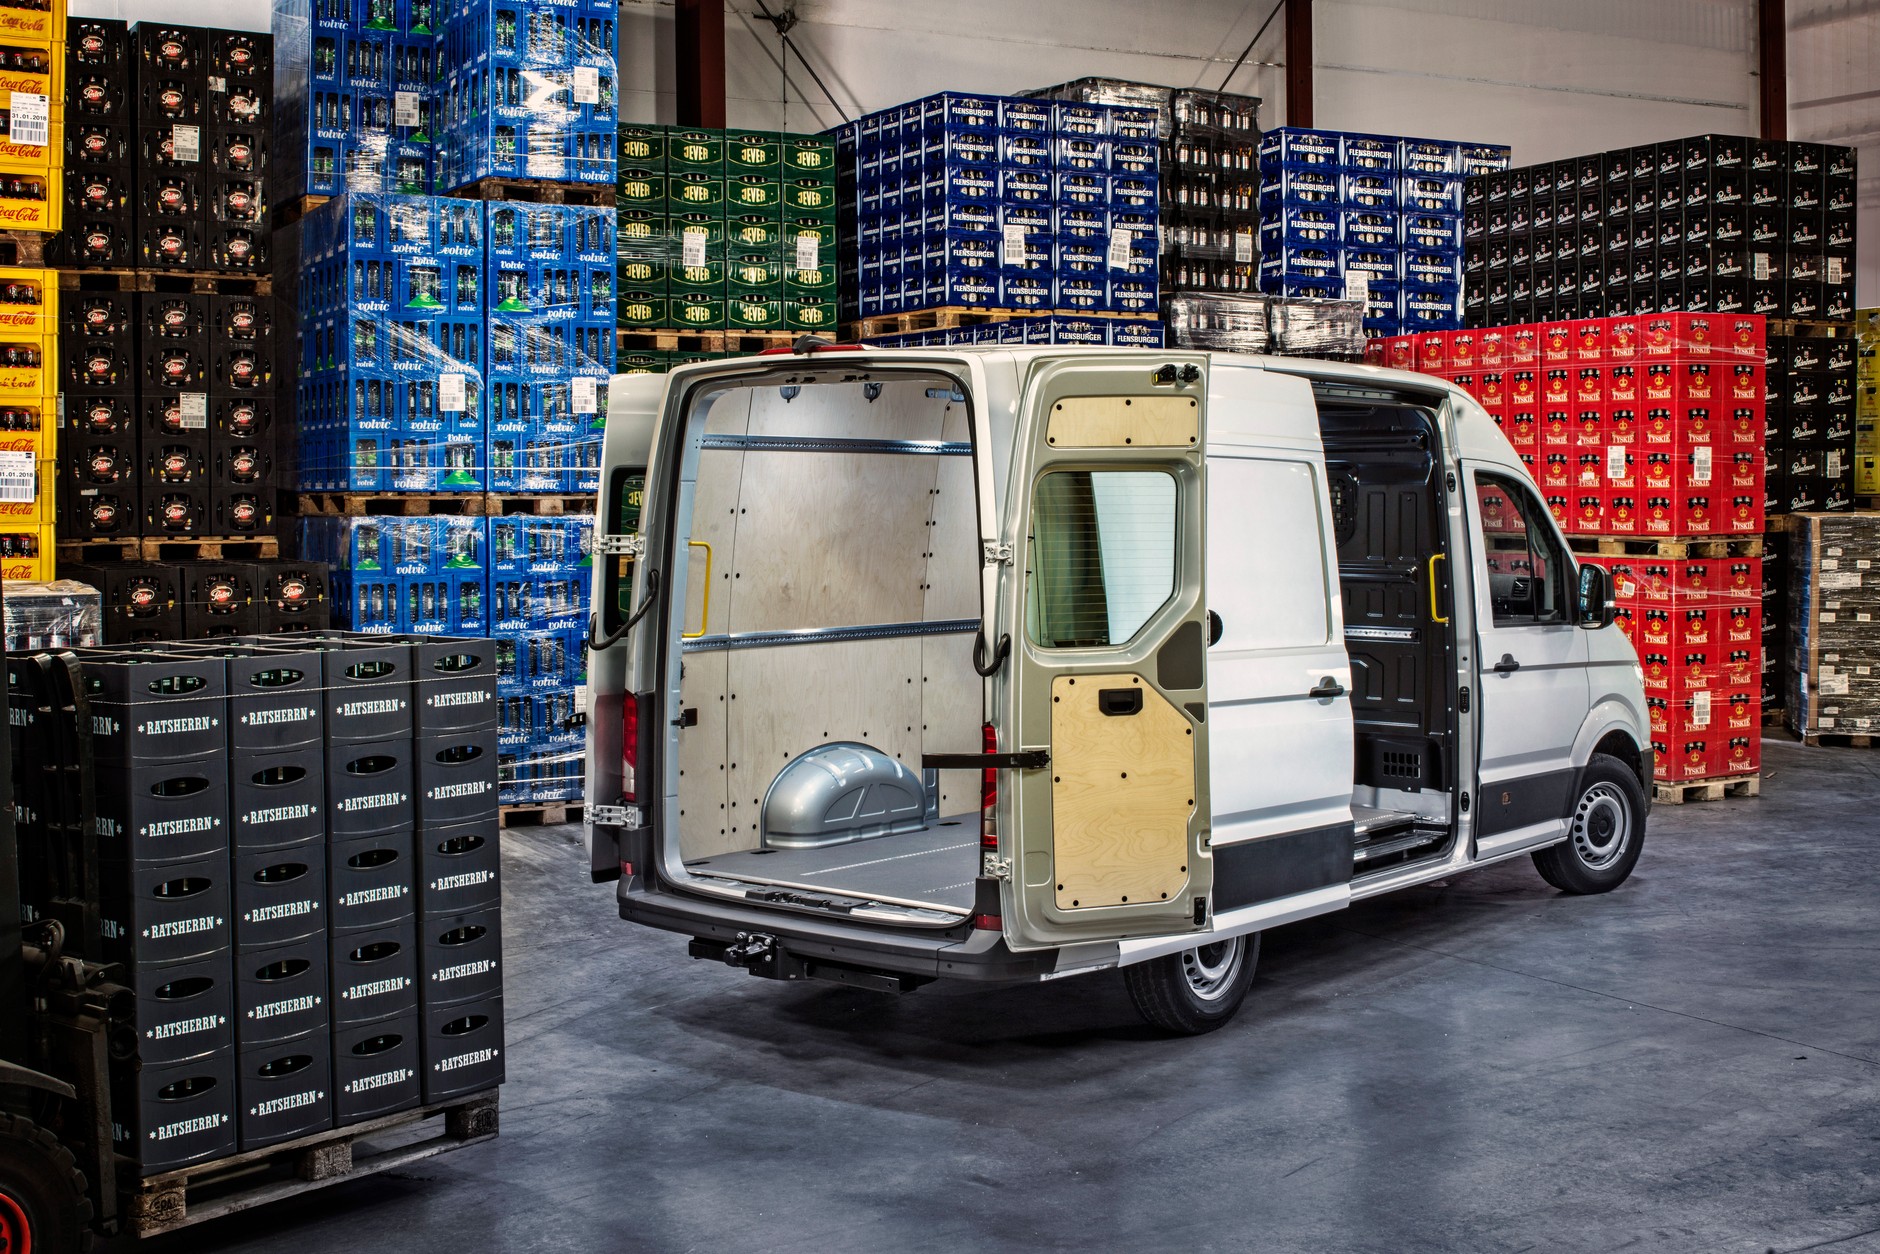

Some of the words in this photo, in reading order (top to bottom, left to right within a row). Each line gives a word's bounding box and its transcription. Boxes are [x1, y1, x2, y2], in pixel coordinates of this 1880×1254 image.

[319, 19, 348, 29] volvic
[351, 78, 379, 88] volvic
[398, 83, 427, 92] volvic
[11, 113, 47, 121] 31.01.2018
[498, 107, 528, 118] volvic
[952, 107, 993, 117] FLENSBURGER
[1007, 112, 1047, 121] FLENSBURGER
[318, 129, 347, 139] volvic
[625, 142, 649, 156] JEVER
[684, 145, 708, 160] JEVER
[953, 142, 993, 152] FLENSBURGER
[1290, 144, 1334, 155] FLENSBURGER
[742, 148, 765, 163] JEVER
[797, 152, 820, 166] JEVER
[1115, 154, 1153, 163] FLENSBURGER
[1349, 149, 1392, 159] FLENSBURGER
[580, 169, 608, 181] volvic
[953, 178, 994, 187] FLENSBURGER
[1008, 181, 1047, 191] FLENSBURGER
[1291, 182, 1335, 193] FLENSBURGER
[625, 182, 649, 197] JEVER
[684, 186, 708, 201] JEVER
[741, 188, 765, 202] JEVER
[1064, 185, 1102, 194] FLENSBURGER
[1115, 188, 1153, 196] FLENSBURGER
[798, 191, 821, 206] JEVER
[953, 212, 994, 223] FLENSBURGER
[1008, 216, 1047, 225] FLENSBURGER
[1064, 219, 1102, 228] FLENSBURGER
[1115, 223, 1153, 231] FLENSBURGER
[1291, 221, 1335, 231] FLENSBURGER
[1350, 224, 1392, 233] FLENSBURGER
[625, 223, 650, 238] JEVER
[742, 228, 766, 242] JEVER
[1410, 227, 1451, 237] FLENSBURGER
[391, 244, 424, 255] volvic
[442, 245, 474, 257] volvic
[953, 249, 994, 257] FLENSBURGER
[580, 253, 608, 262] volvic
[1063, 254, 1102, 262] FLENSBURGER
[1291, 257, 1335, 269] FLENSBURGER
[626, 264, 651, 279] JEVER
[1349, 262, 1392, 272] FLENSBURGER
[1410, 264, 1451, 273] FLENSBURGER
[685, 266, 709, 281] JEVER
[742, 267, 766, 282] JEVER
[798, 269, 821, 284] JEVER
[954, 284, 994, 293] FLENSBURGER
[1008, 287, 1048, 296] FLENSBURGER
[1063, 288, 1102, 297] FLENSBURGER
[358, 300, 389, 312] volvic
[627, 304, 651, 319] JEVER
[1410, 302, 1451, 312] FLENSBURGER
[547, 308, 576, 319] volvic
[686, 307, 710, 321] JEVER
[743, 307, 767, 321] JEVER
[800, 308, 822, 323] JEVER
[1059, 332, 1101, 341] FLENSBURGER
[1118, 335, 1158, 343] FLENSBURGER
[1546, 350, 1568, 360] TYSKIE
[1648, 345, 1670, 355] TYSKIE
[393, 360, 424, 370] volvic
[530, 364, 560, 375] volvic
[1513, 393, 1534, 404] TYSKIE
[1546, 391, 1568, 402] TYSKIE
[1578, 392, 1600, 402] TYSKIE
[1611, 389, 1635, 400] TYSKIE
[1647, 388, 1671, 399] TYSKIE
[1688, 388, 1711, 398] TYSKIE
[1733, 388, 1755, 398] TYSKIE
[359, 418, 390, 429] volvic
[410, 420, 442, 432] volvic
[497, 421, 527, 432] volvic
[546, 422, 575, 433] volvic
[1513, 435, 1534, 445] TYSKIE
[1612, 433, 1634, 443] TYSKIE
[1647, 432, 1671, 443] TYSKIE
[1688, 432, 1710, 442] TYSKIE
[1733, 432, 1755, 442] TYSKIE
[1646, 477, 1670, 488] TYSKIE
[1733, 476, 1754, 486] TYSKIE
[628, 491, 644, 506] JEV
[1578, 520, 1600, 530] TYSKIE
[1611, 520, 1634, 531] TYSKIE
[1687, 521, 1710, 531] TYSKIE
[1732, 520, 1754, 530] TYSKIE
[396, 563, 427, 574] volvic
[414, 621, 445, 632] volvic
[499, 619, 529, 630] volvic
[548, 618, 577, 629] volvic
[1644, 634, 1668, 644] TYSKIE
[1685, 634, 1708, 644] TYSKIE
[1729, 631, 1751, 641] TYSKIE
[533, 676, 561, 687] volvic
[434, 691, 483, 707] RATSHERRN
[344, 699, 398, 716] RATSHERRN
[250, 707, 307, 725] RATSHERRN
[147, 717, 209, 734] RATSHERRN
[1729, 718, 1750, 728] TYSKIE
[500, 734, 529, 744] volvic
[1684, 765, 1706, 776] TYSKIE
[434, 781, 485, 799] RATSHERRN
[345, 792, 399, 811] RATSHERRN
[251, 804, 308, 824] RATSHERRN
[149, 817, 211, 837] RATSHERRN
[438, 871, 487, 890] RATSHERRN
[347, 885, 400, 906] RATSHERRN
[252, 901, 310, 922] RATSHERRN
[152, 916, 213, 938] RATSHERRN
[439, 960, 489, 981] RATSHERRN
[350, 977, 403, 999] RATSHERRN
[256, 996, 313, 1019] RATSHERRN
[155, 1015, 216, 1039] RATSHERRN
[442, 1048, 491, 1071] RATSHERRN
[352, 1069, 406, 1093] RATSHERRN
[259, 1091, 315, 1116] RATSHERRN
[158, 1114, 219, 1140] RATSHERRN
